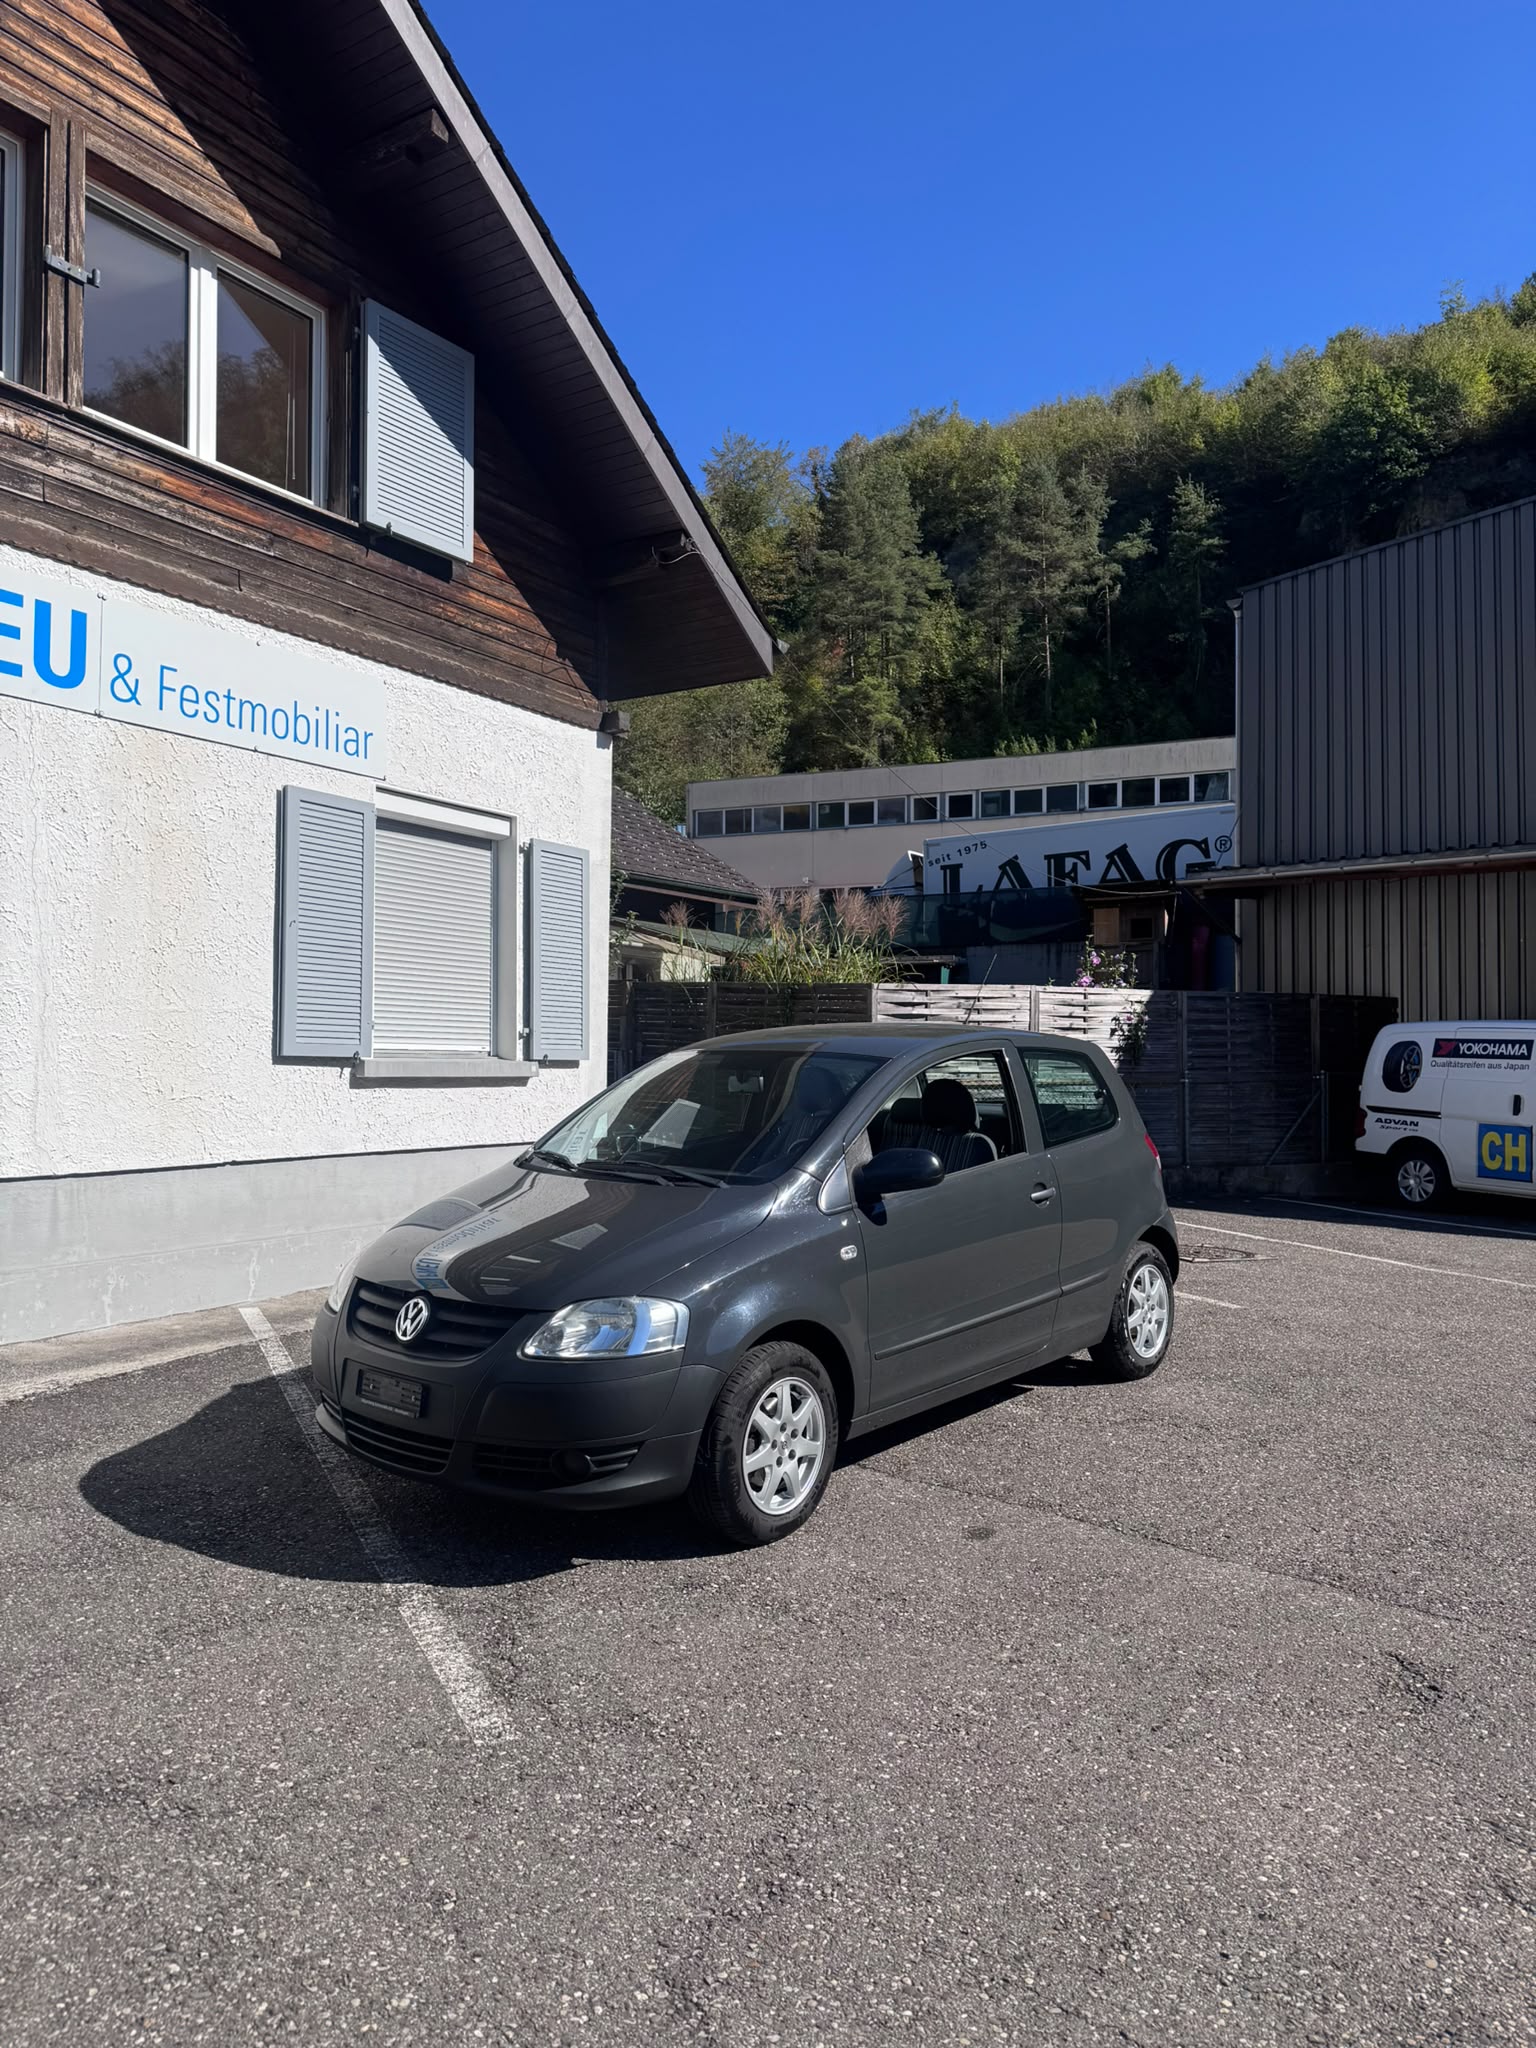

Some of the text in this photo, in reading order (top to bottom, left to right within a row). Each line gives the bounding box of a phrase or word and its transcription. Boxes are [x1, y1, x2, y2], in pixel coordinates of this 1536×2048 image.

[110, 652, 142, 706] &
[159, 664, 374, 760] Festmobiliar
[928, 840, 987, 867] seit 1975
[1459, 1042, 1528, 1056] YOKOHAMA
[1430, 1060, 1530, 1072] Qualitätsreifen aus Japan
[1375, 1117, 1419, 1127] ADVAN
[1481, 1131, 1527, 1173] CH
